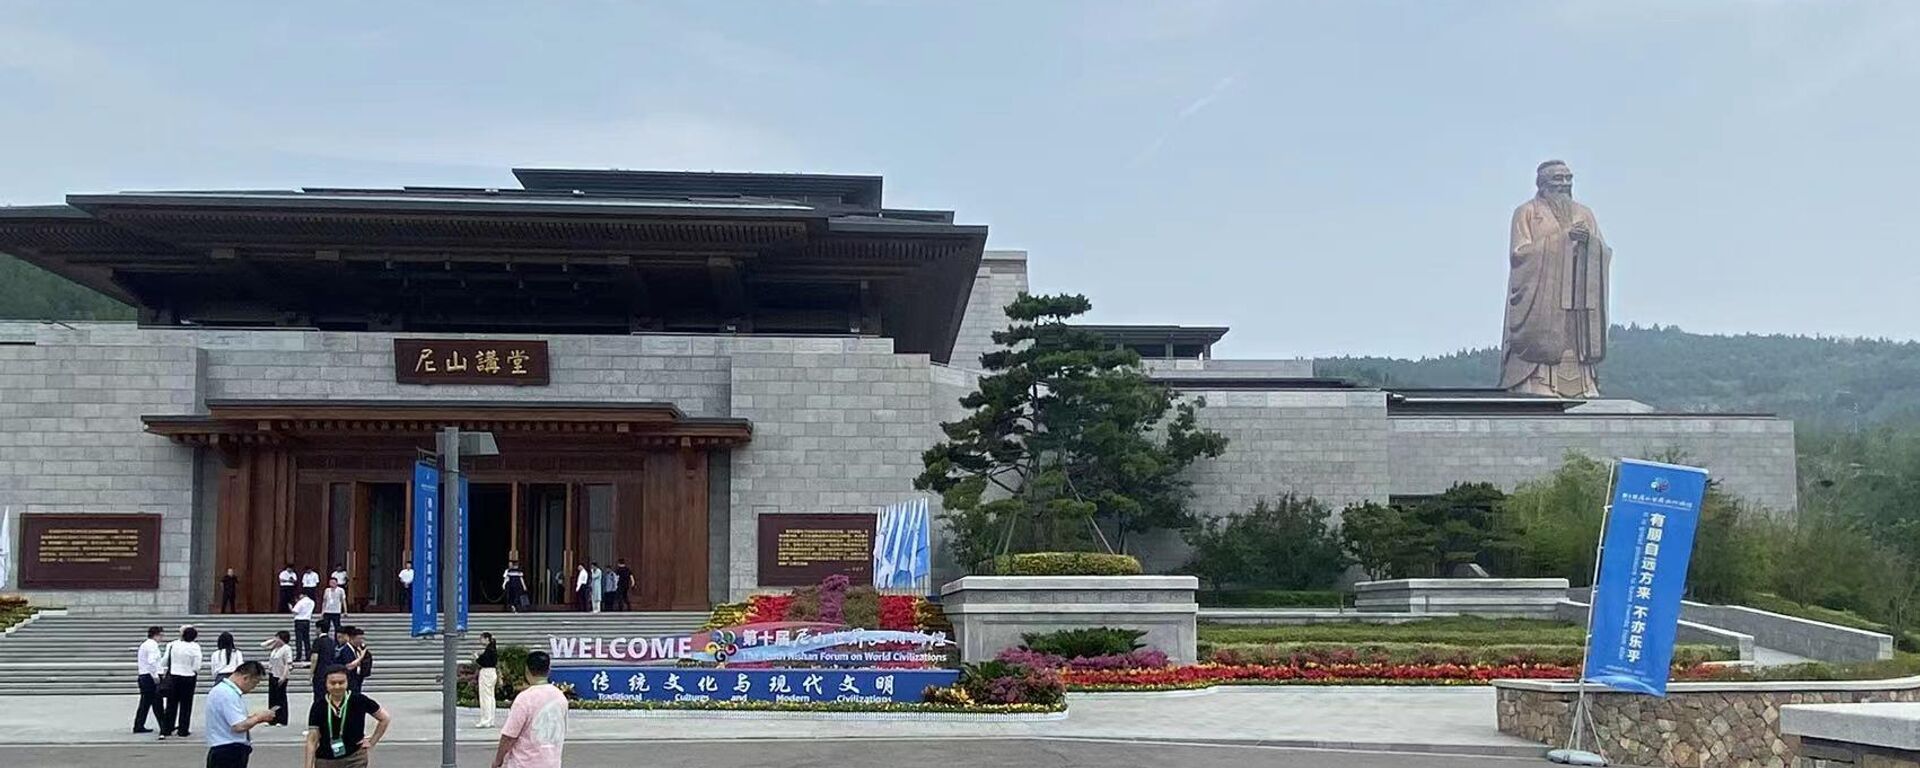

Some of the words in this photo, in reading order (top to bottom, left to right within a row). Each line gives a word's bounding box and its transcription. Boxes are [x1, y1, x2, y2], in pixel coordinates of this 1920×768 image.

[414, 347, 530, 375] 尼山講堂
[1636, 512, 1667, 600] 有朋自远方来
[1627, 605, 1649, 663] 不亦乐乎
[549, 637, 692, 659] WELCOME
[820, 652, 849, 661] Forum
[864, 652, 891, 661] World
[893, 652, 947, 662] Civilizations
[591, 671, 894, 695] 传统文化与现代文明
[598, 693, 642, 702] Traditional
[674, 693, 710, 702] Cultures
[730, 693, 747, 702] and
[775, 693, 810, 703] Modern
[836, 694, 892, 703] Civilizations
